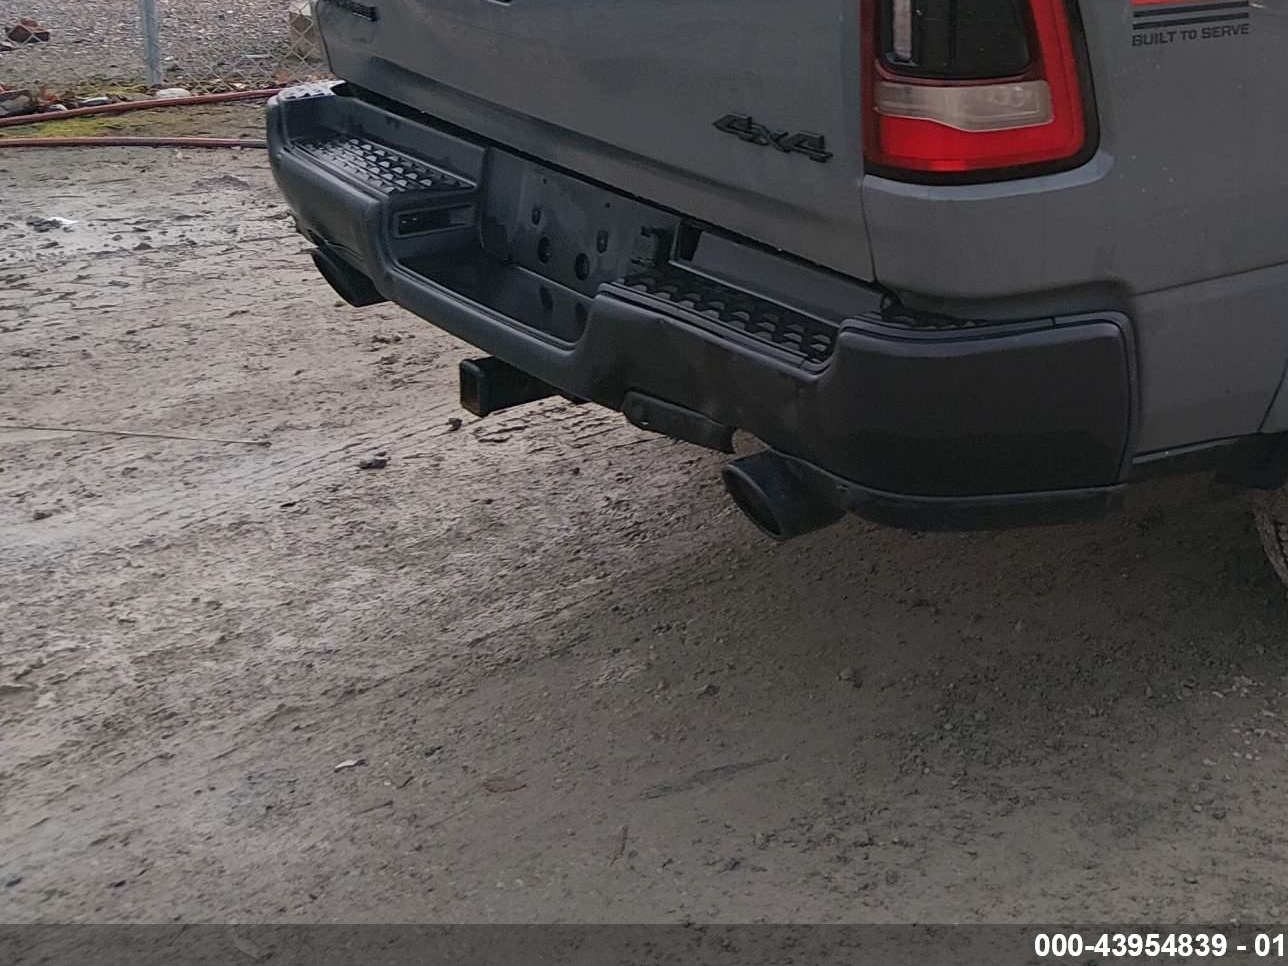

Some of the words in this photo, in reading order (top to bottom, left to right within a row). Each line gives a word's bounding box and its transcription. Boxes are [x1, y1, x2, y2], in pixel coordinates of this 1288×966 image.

[1132, 31, 1176, 47] BUILT
[1181, 29, 1197, 40] TO
[1201, 23, 1250, 39] SERVE
